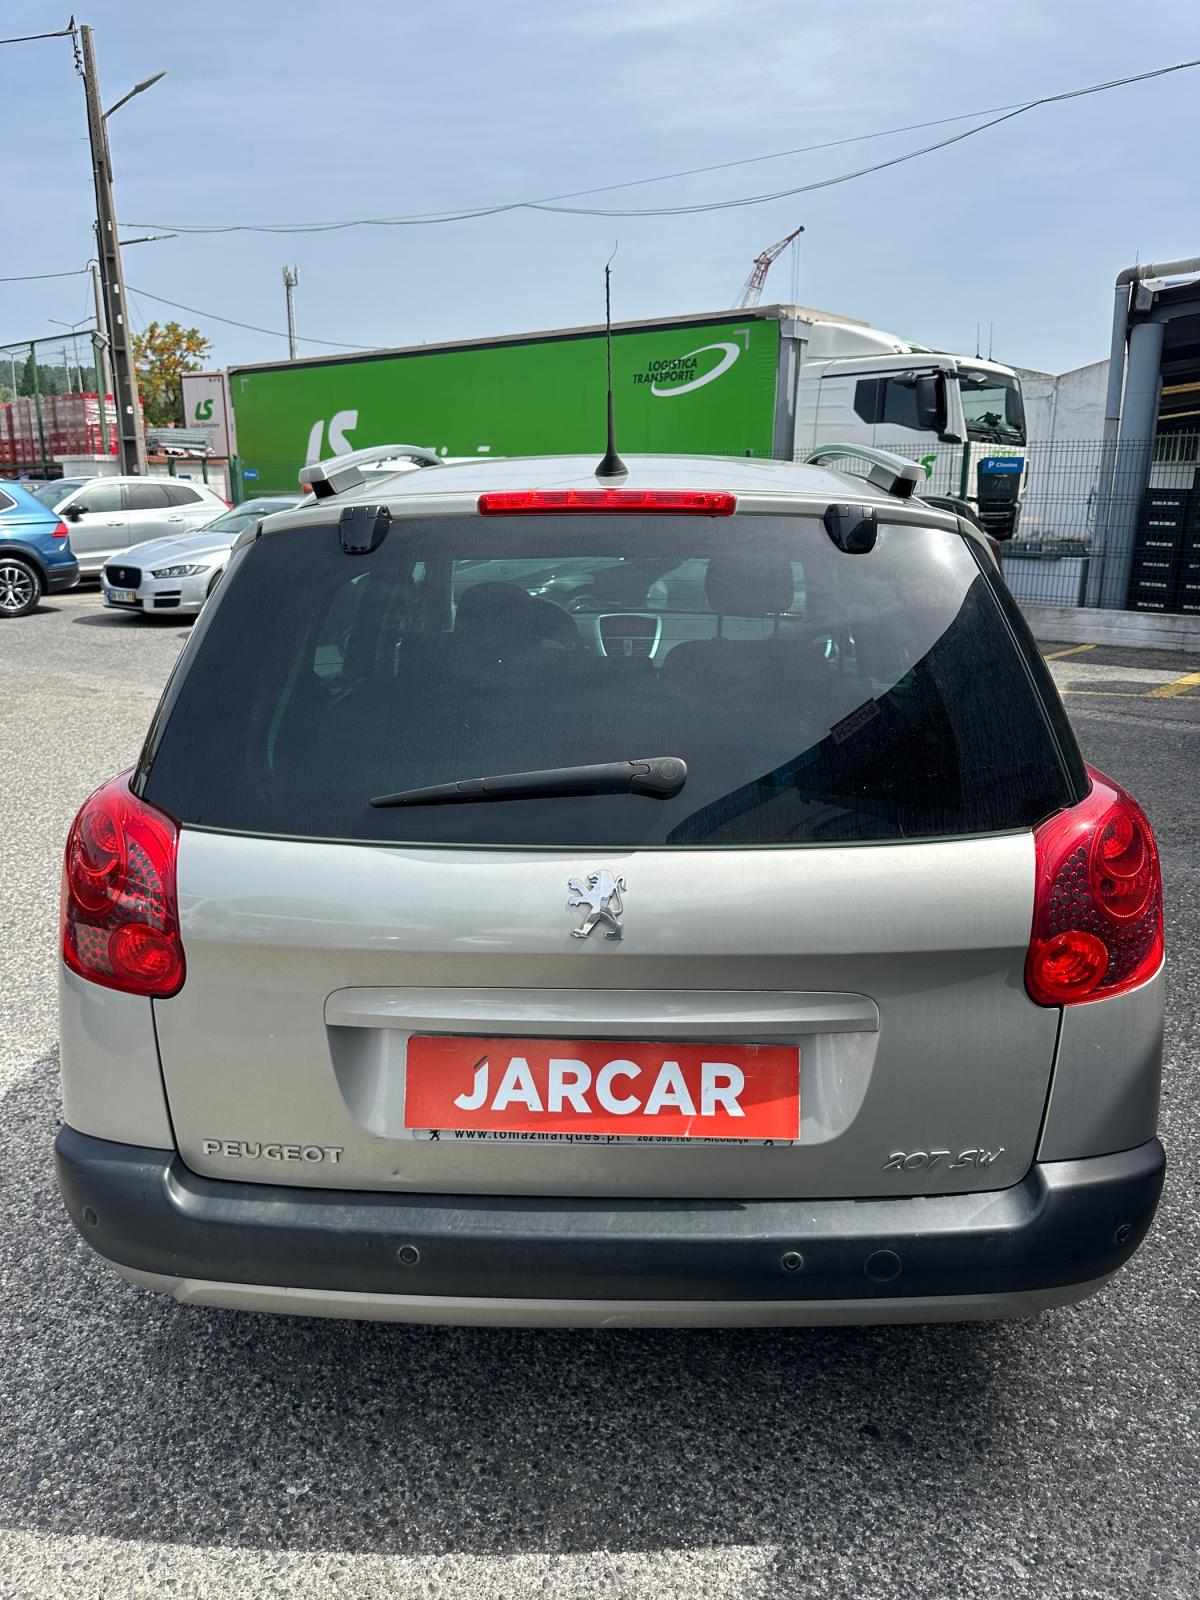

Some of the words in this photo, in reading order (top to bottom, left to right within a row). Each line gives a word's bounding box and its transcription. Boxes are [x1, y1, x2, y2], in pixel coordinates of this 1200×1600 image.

[633, 370, 695, 385] TRANSPORTE
[195, 399, 213, 421] LS
[454, 1055, 746, 1118] JARCAR
[201, 1138, 345, 1164] PEUGEOT
[882, 1149, 951, 1169] 207
[949, 1146, 1006, 1169] SW
